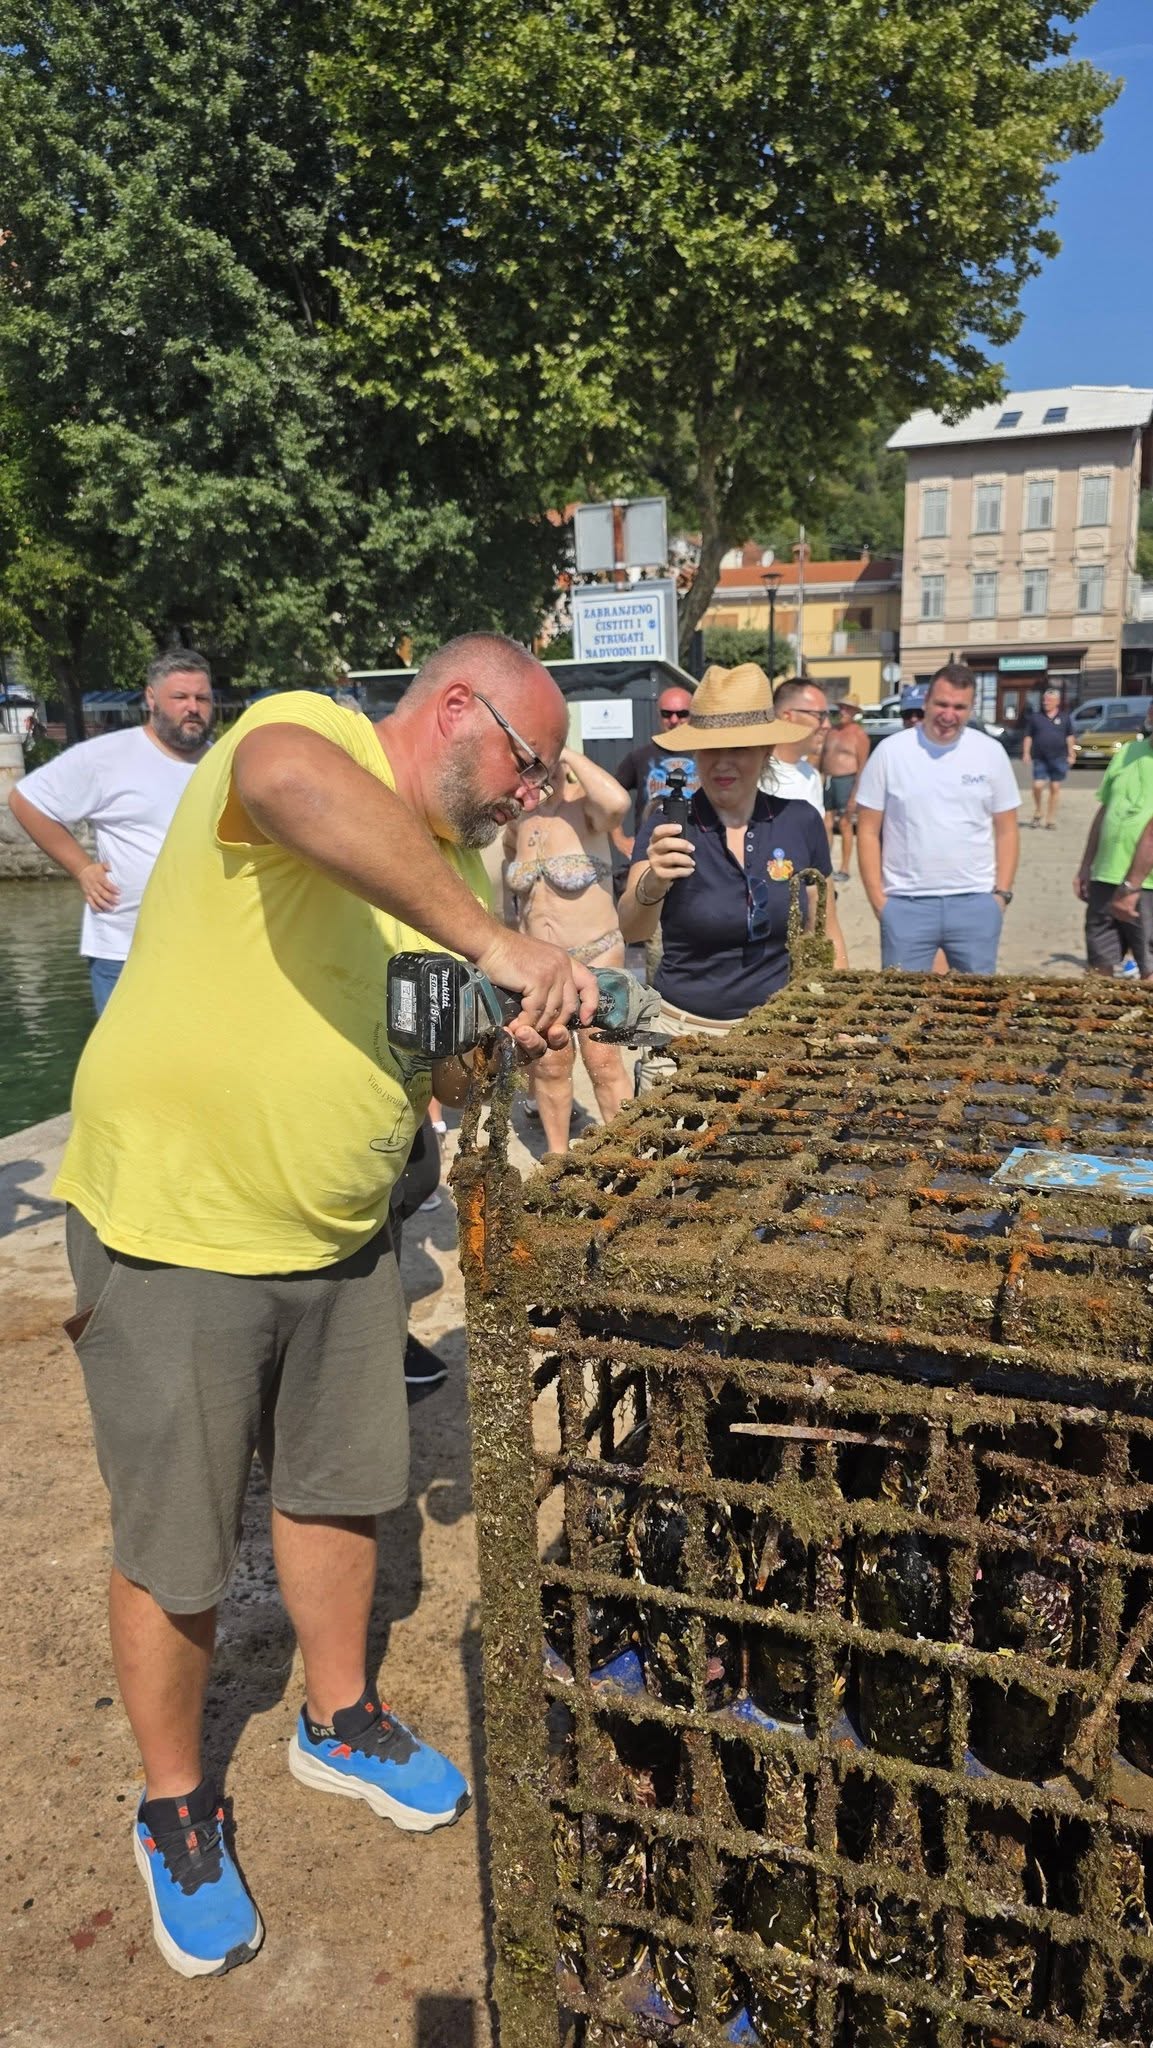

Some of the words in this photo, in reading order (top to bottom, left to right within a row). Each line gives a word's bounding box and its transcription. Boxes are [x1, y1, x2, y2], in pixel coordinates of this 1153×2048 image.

[584, 604, 653, 619] ZABRANJENO
[637, 618, 642, 629] I
[593, 632, 644, 645] STRUGATI
[585, 646, 637, 659] NADVODNI
[640, 644, 655, 656] ILI
[368, 1074, 383, 1095] Vino
[311, 1726, 337, 1737] CAT
